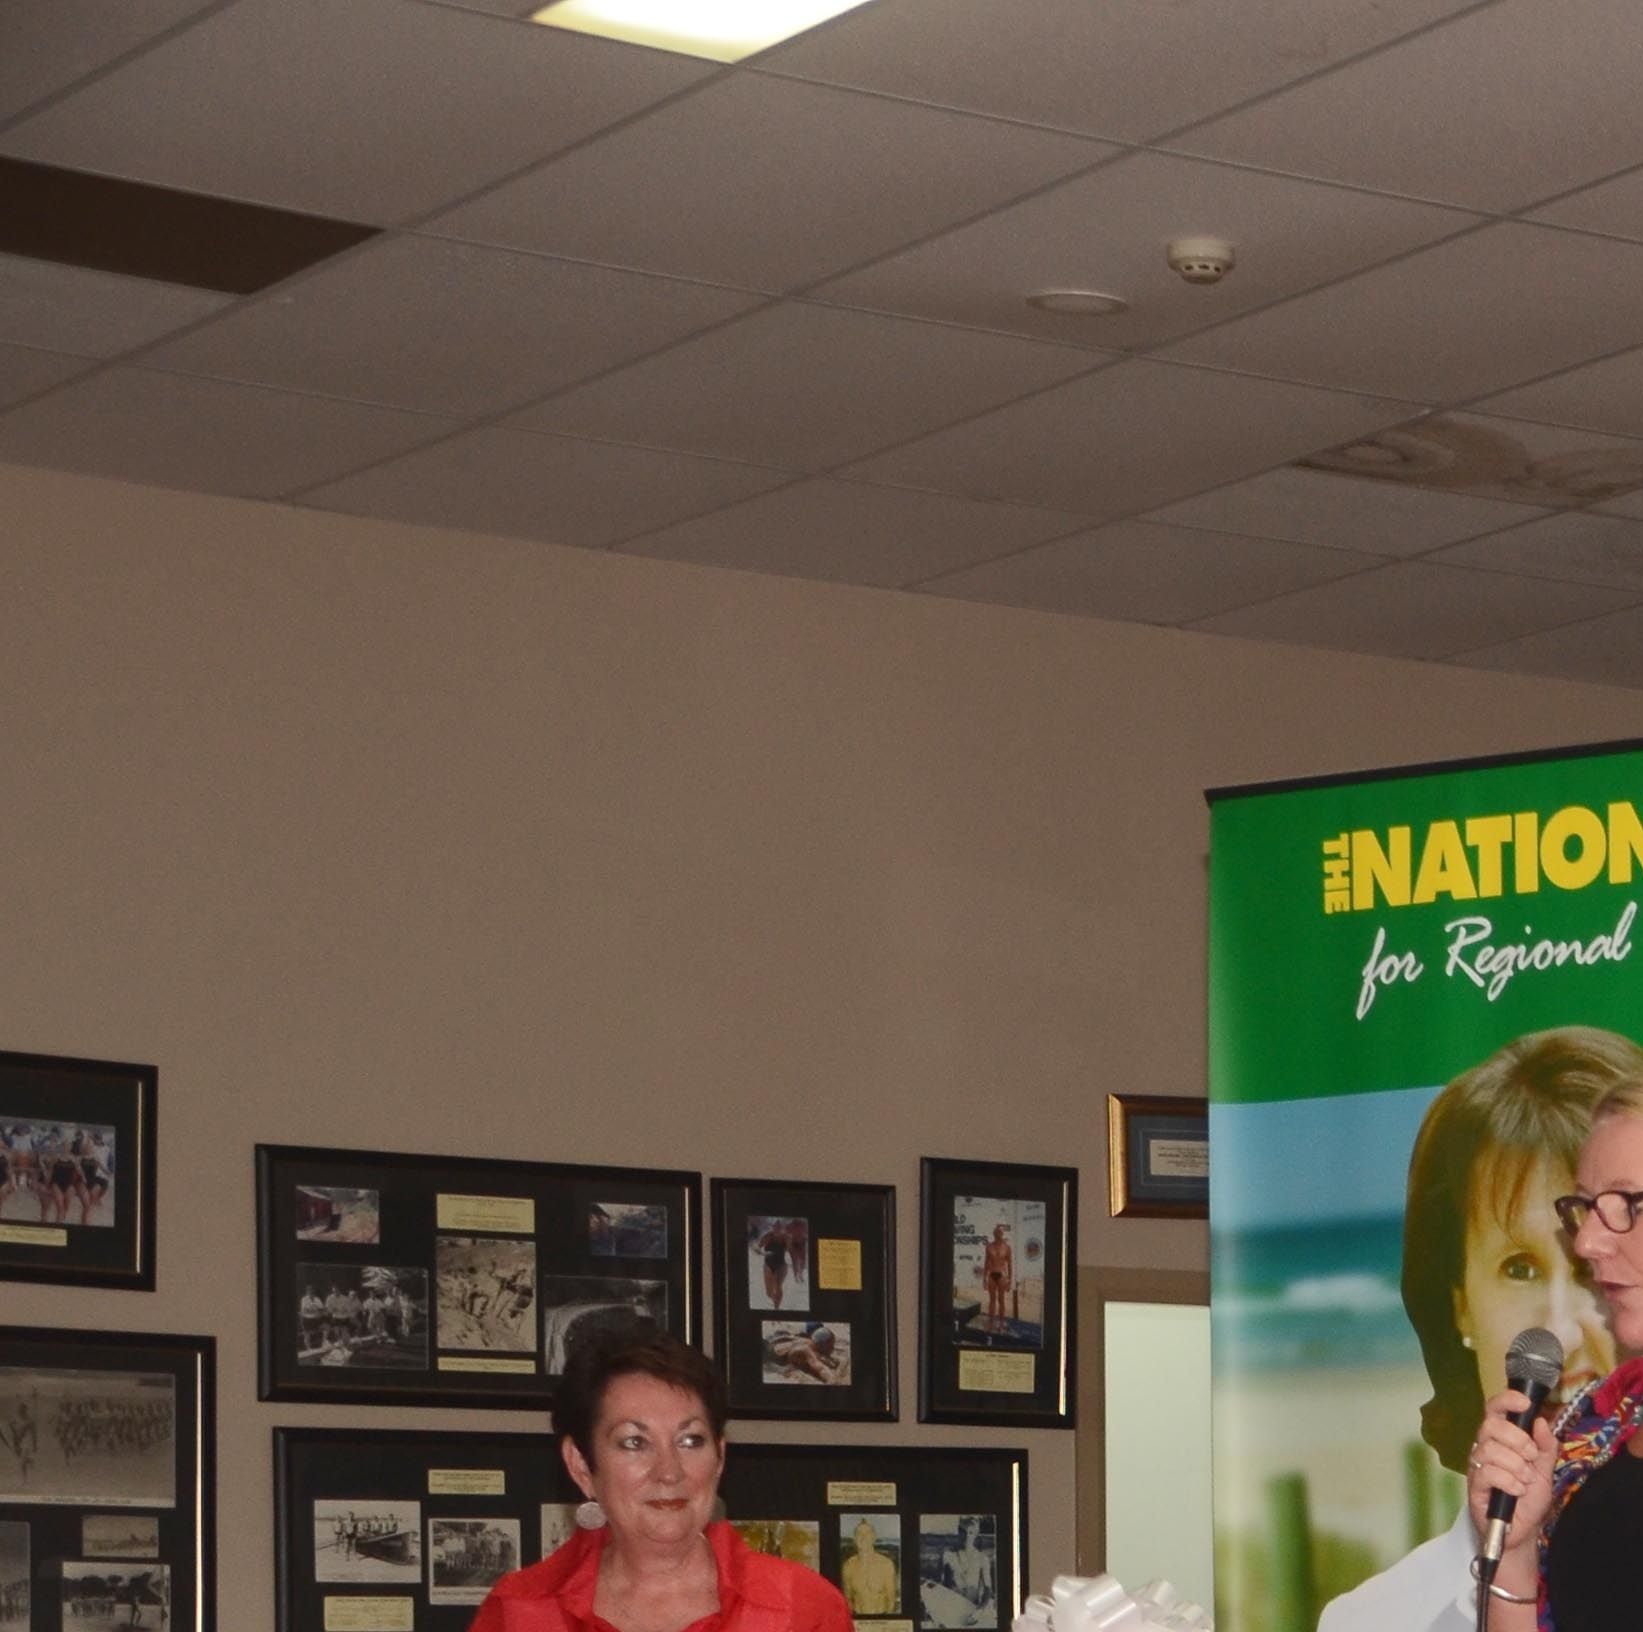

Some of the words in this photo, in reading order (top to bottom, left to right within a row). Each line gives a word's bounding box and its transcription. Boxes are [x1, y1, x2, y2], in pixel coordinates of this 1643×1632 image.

[1322, 832, 1351, 915] THE
[1356, 927, 1424, 1021] for
[1444, 901, 1636, 1001] Regional
